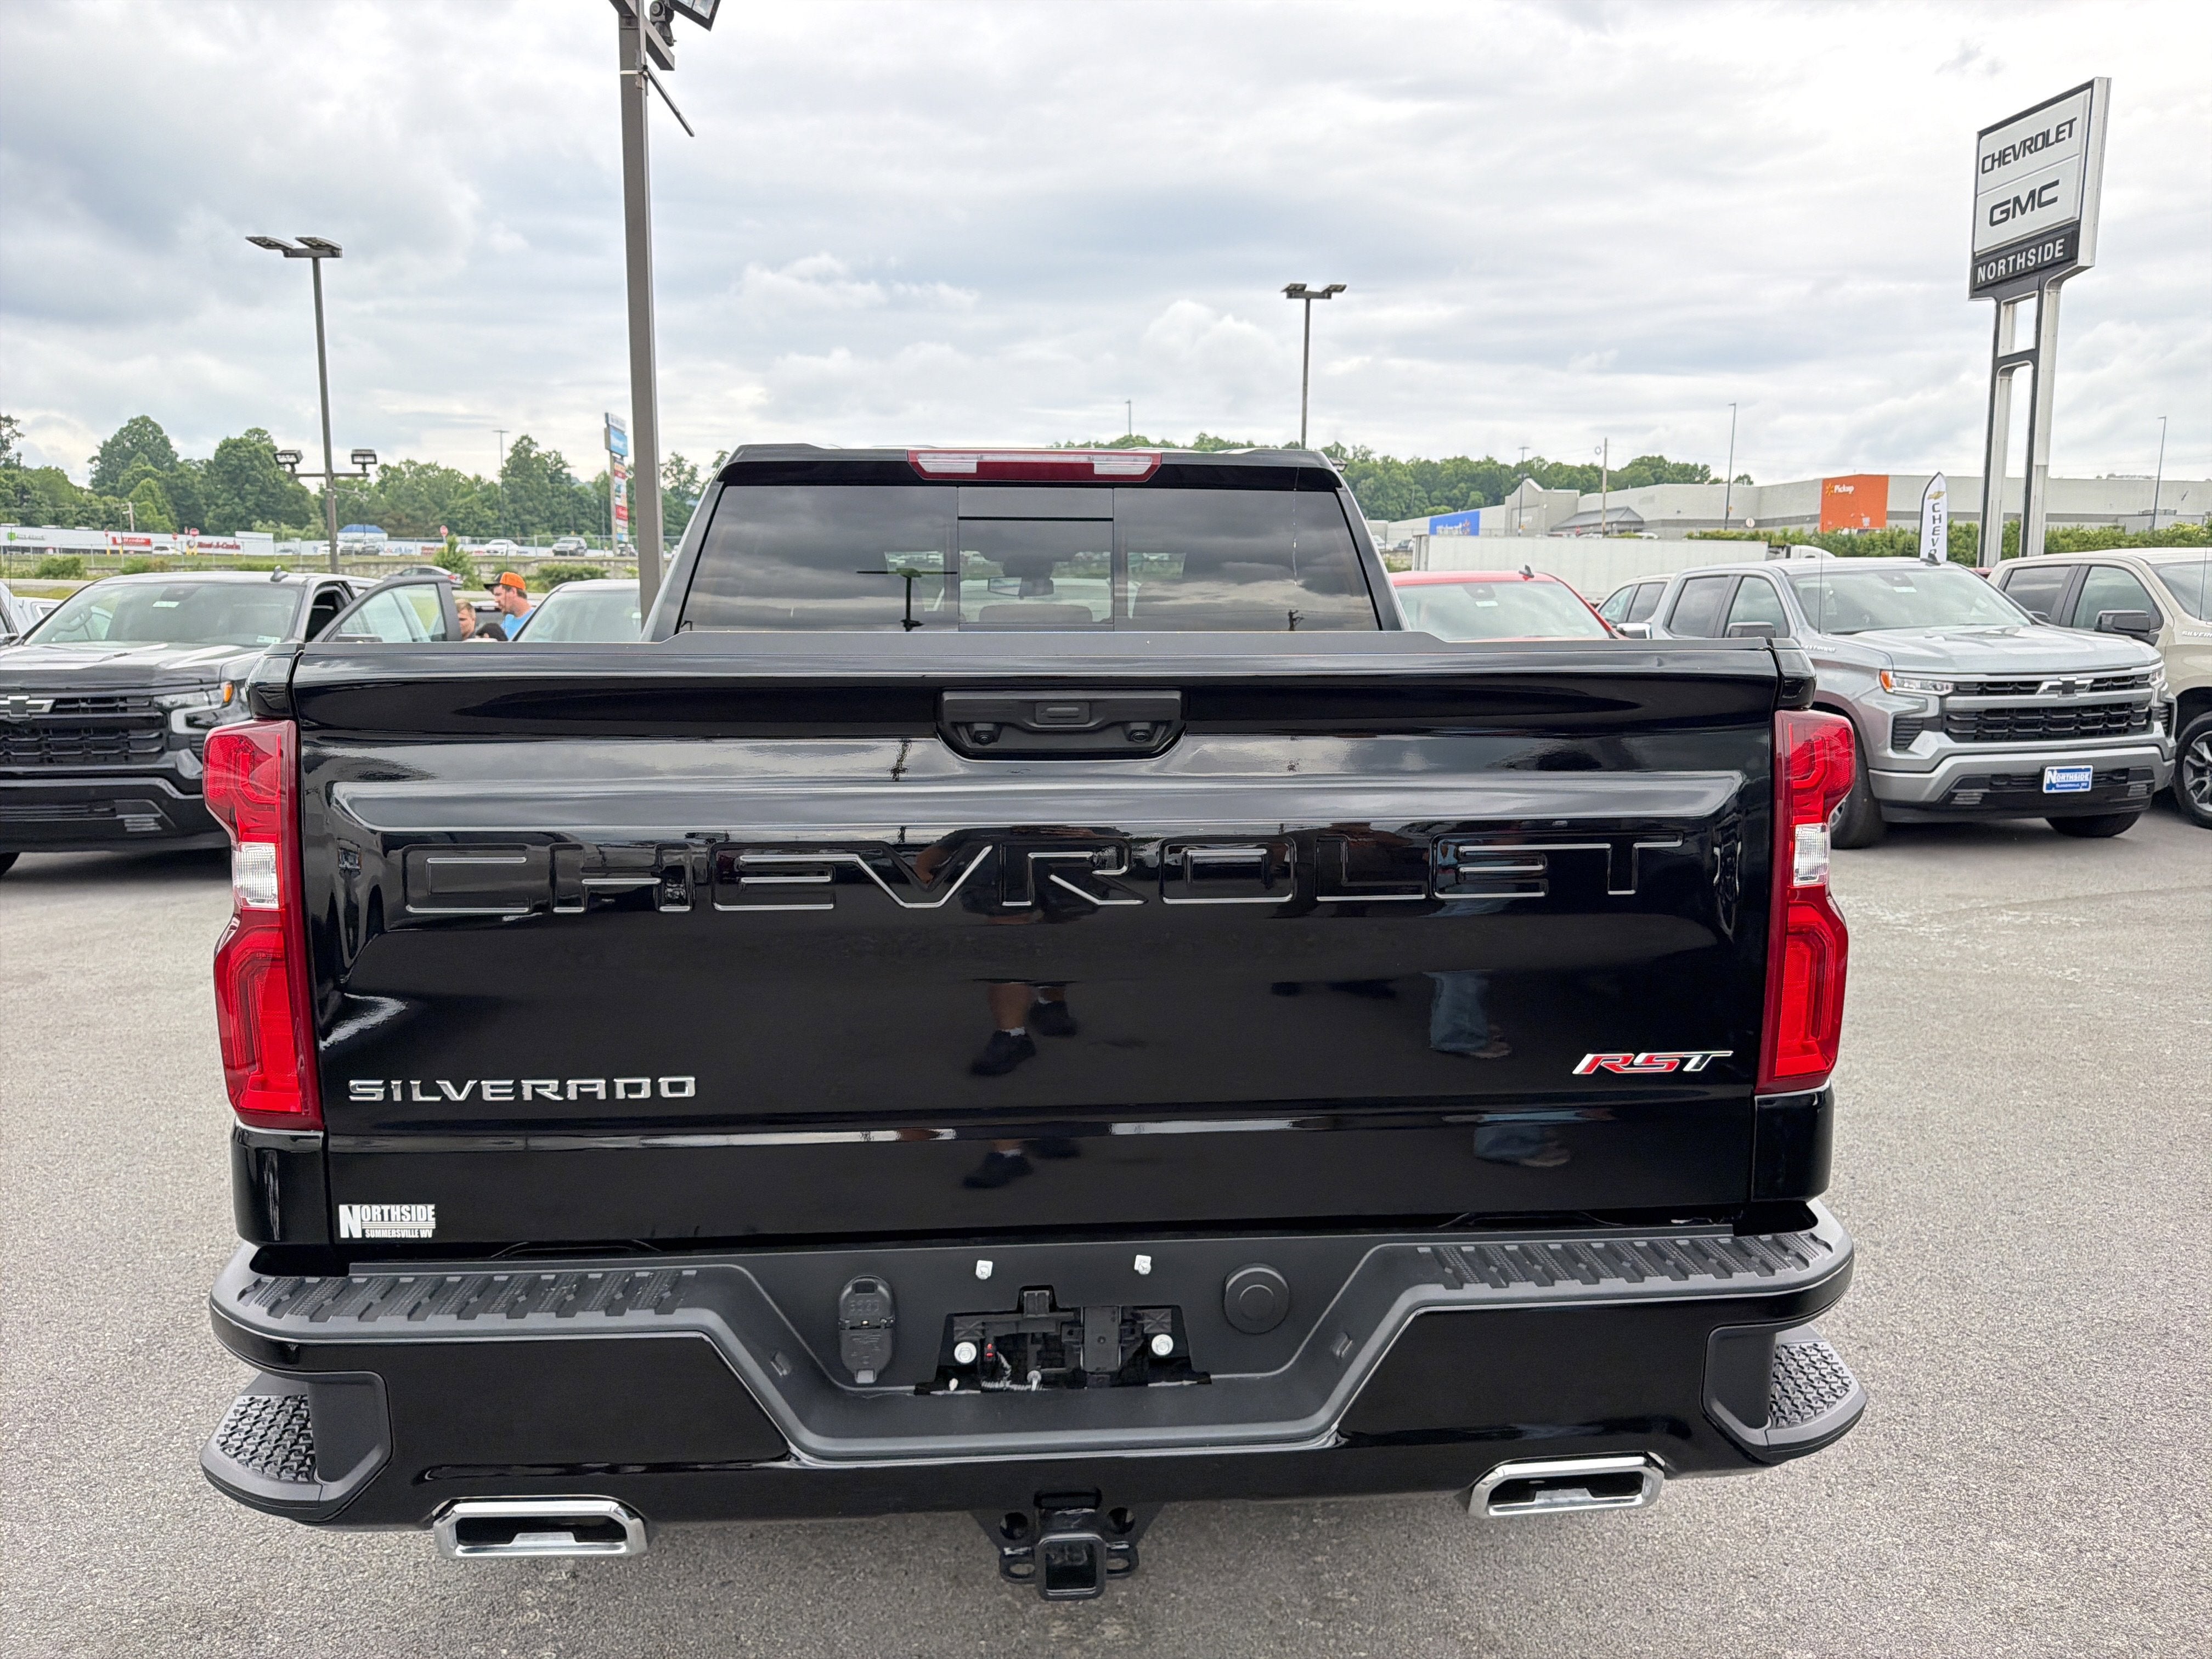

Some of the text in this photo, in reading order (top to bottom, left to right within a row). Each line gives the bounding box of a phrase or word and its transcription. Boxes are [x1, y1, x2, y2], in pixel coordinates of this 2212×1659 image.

[1982, 117, 2078, 174] CHEVROLET
[1989, 179, 2059, 227] GMC
[1977, 239, 2065, 283] NORTHSIDE
[402, 831, 1684, 915] CHEVROLET
[1572, 1051, 1734, 1074] RST
[349, 1076, 696, 1101] SILVERADO
[339, 1204, 435, 1238] NORTHSIDE
[365, 1229, 432, 1238] SUMMERSVILLE WV
